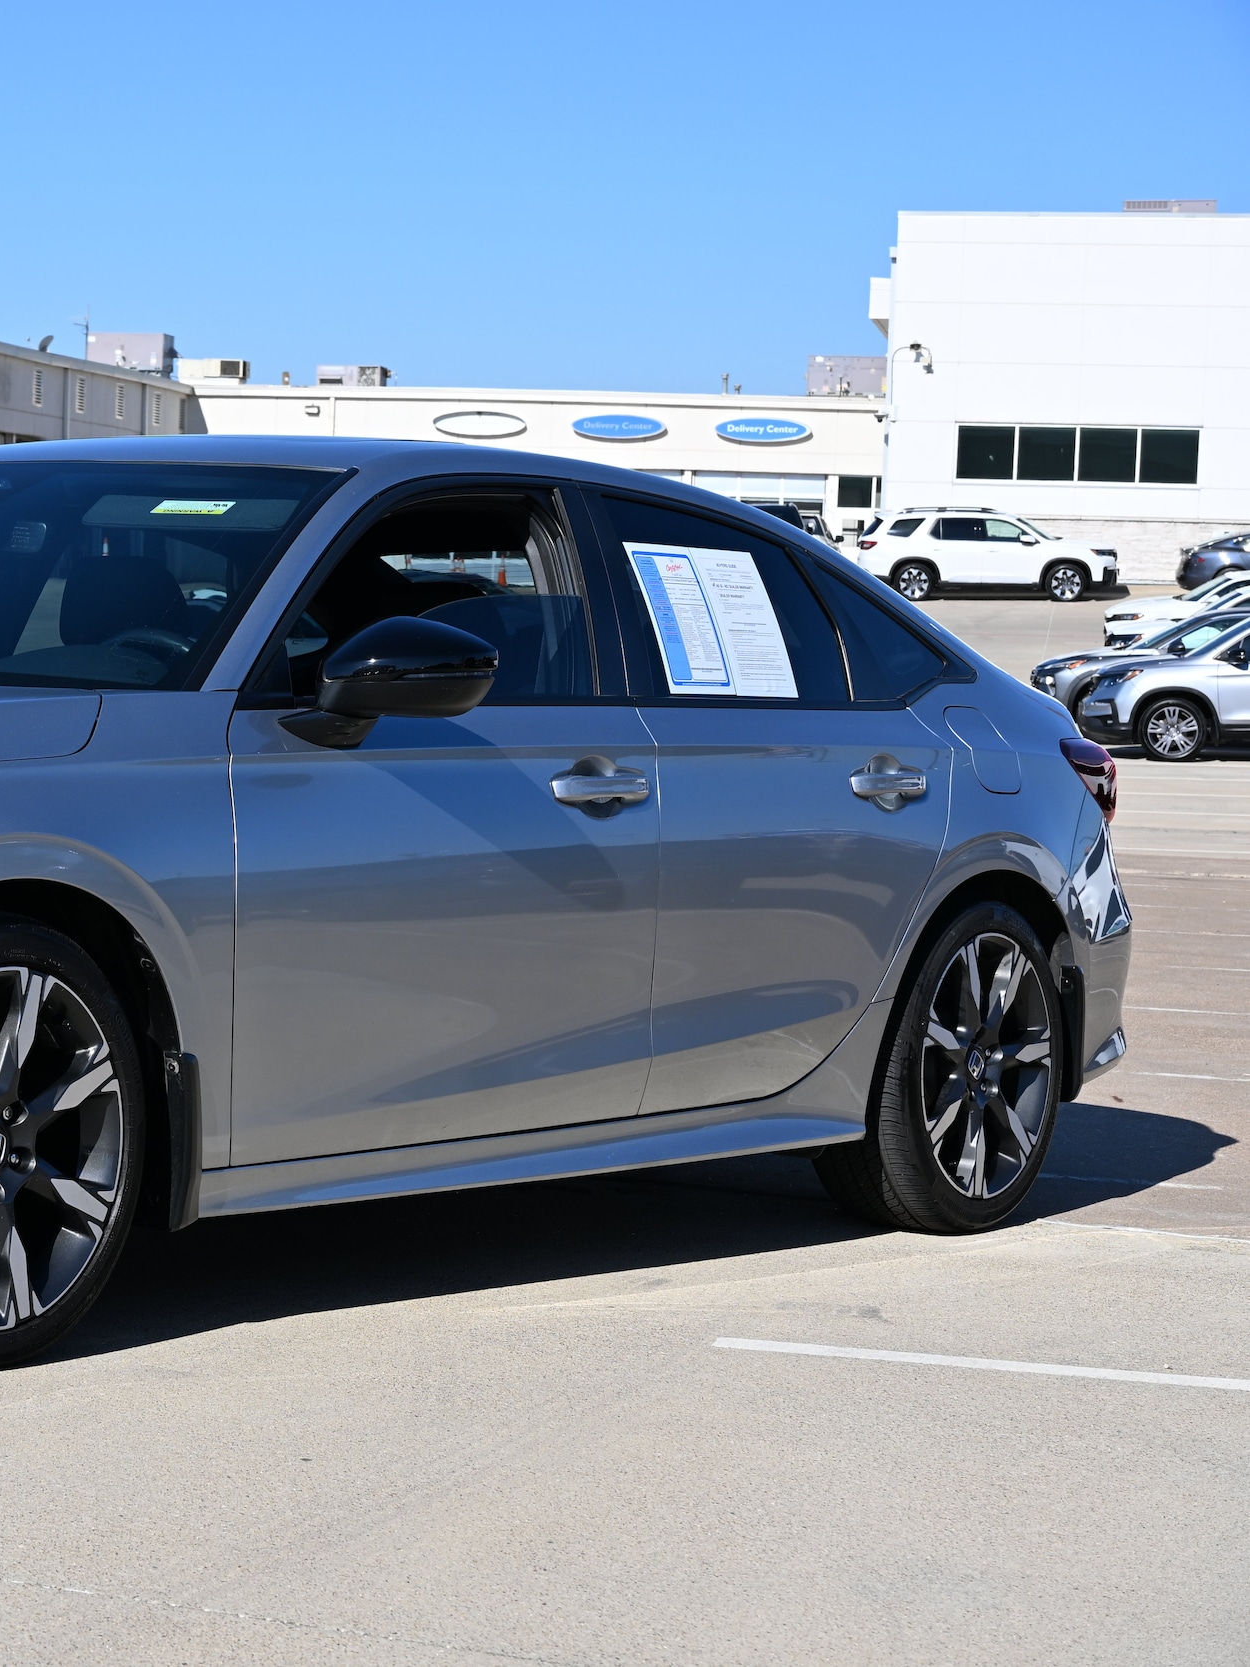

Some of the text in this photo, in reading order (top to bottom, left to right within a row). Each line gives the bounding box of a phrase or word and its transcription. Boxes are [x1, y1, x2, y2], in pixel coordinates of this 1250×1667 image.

[583, 421, 653, 431] Delivery Center
[727, 424, 798, 435] Delivery Center
